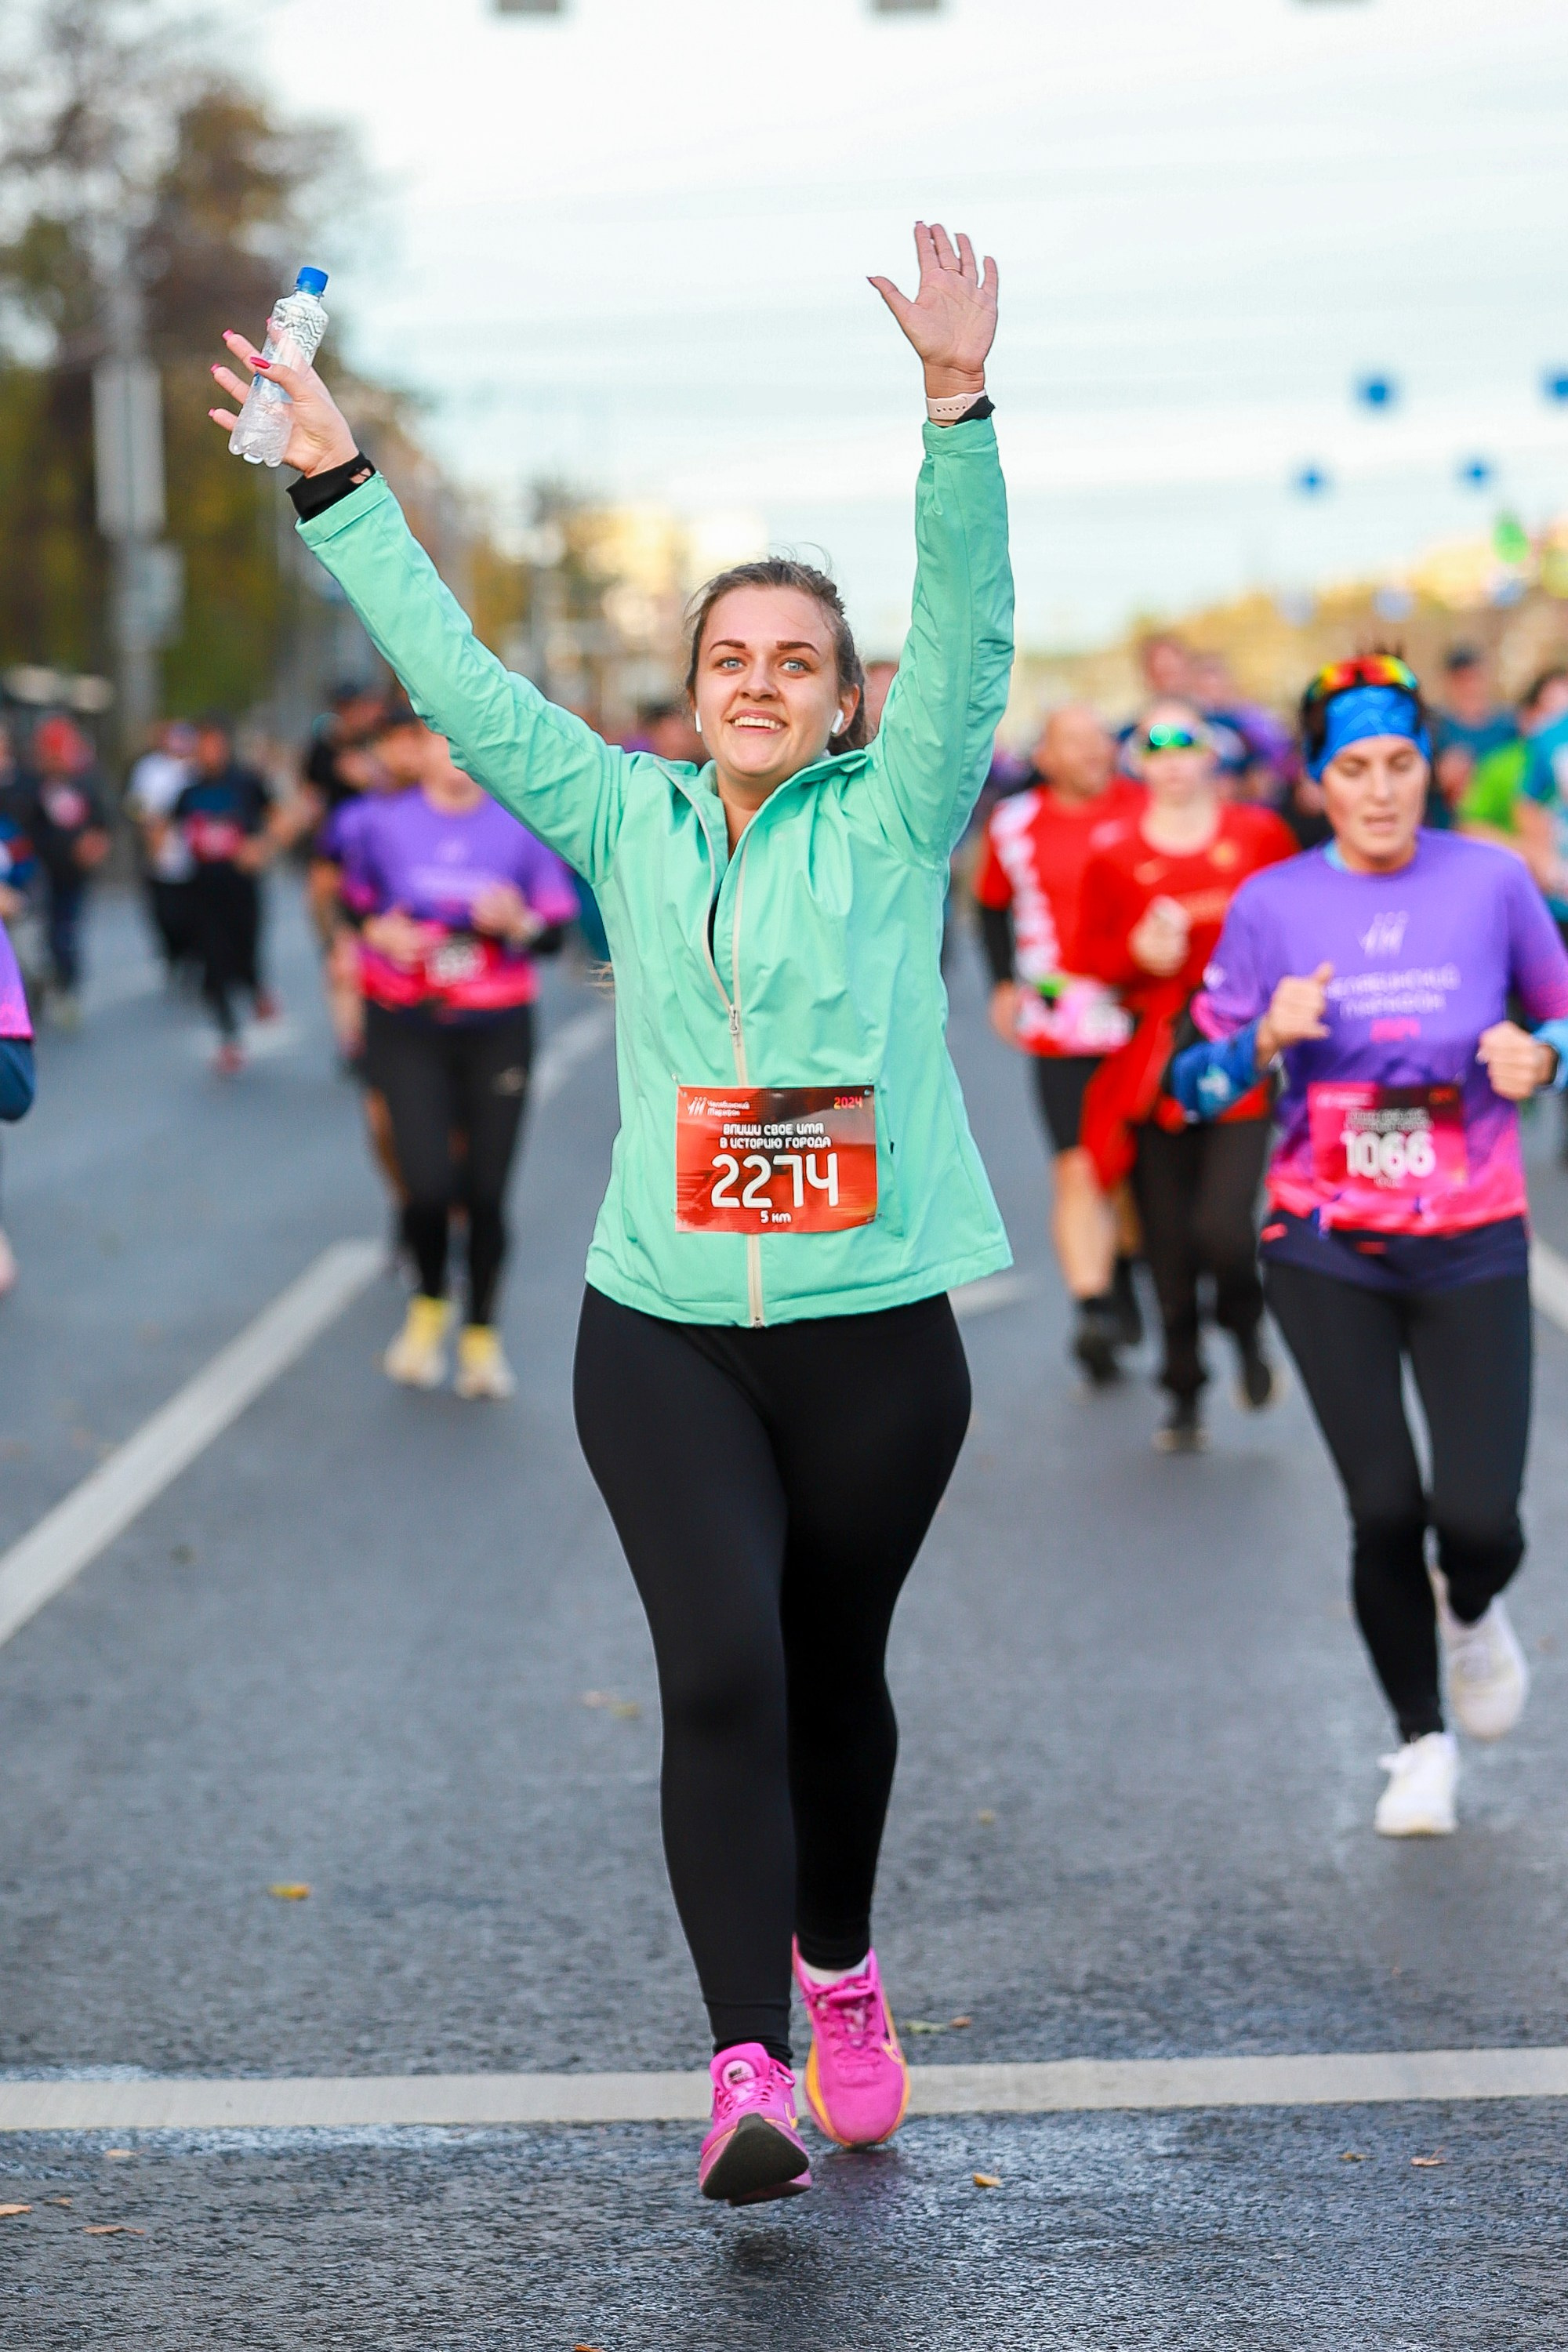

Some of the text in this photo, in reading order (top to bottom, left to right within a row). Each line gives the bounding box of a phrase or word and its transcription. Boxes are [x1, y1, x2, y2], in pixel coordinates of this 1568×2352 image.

[834, 1096, 862, 1109] 2024
[723, 1123, 825, 1136] ВПИШИ СВОЕ ИМЯ
[720, 1137, 832, 1149] В ИСТОРИЮ ГОРОДА
[1340, 1129, 1436, 1178] 1066
[711, 1153, 839, 1208] 2274
[760, 1210, 769, 1224] 5
